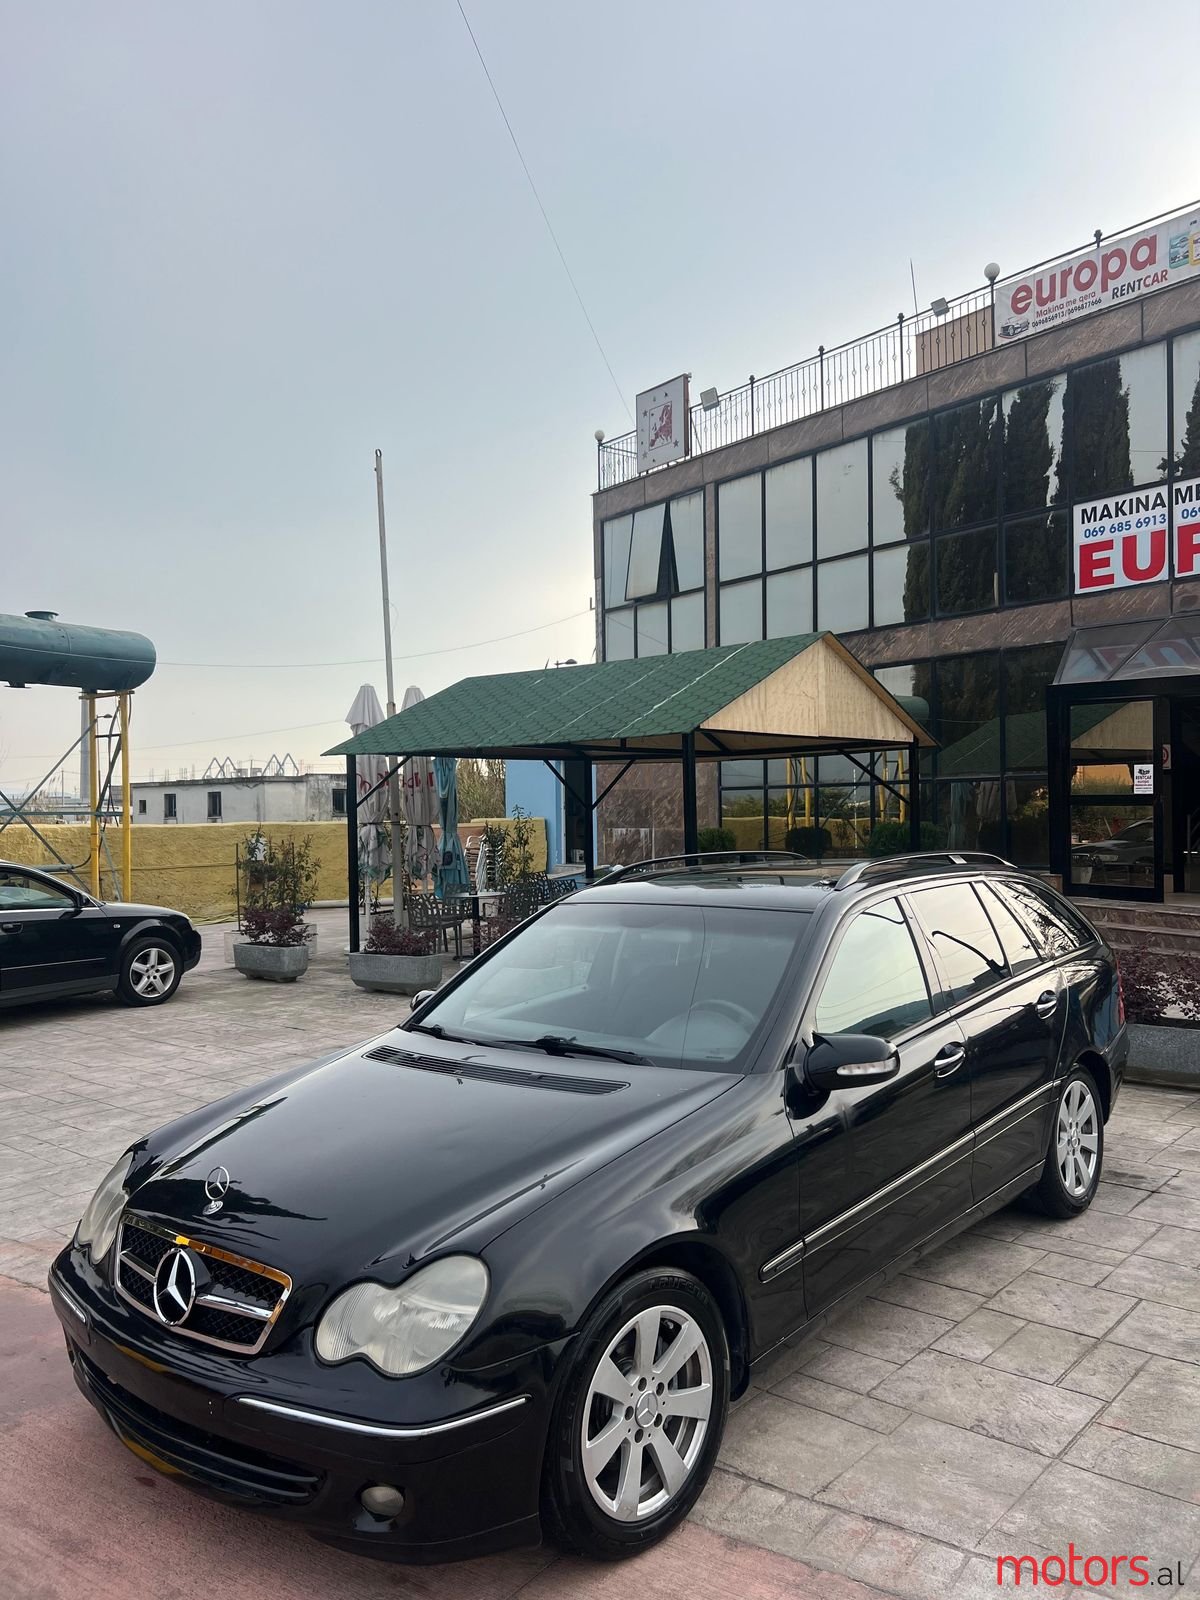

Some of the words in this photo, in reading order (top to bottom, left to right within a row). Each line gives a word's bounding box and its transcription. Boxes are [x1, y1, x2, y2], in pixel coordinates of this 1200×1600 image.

[1010, 234, 1157, 315] europa
[1036, 303, 1064, 318] Makina
[1065, 298, 1077, 307] me
[1081, 492, 1167, 525] MAKINA
[1084, 525, 1105, 538] 069
[1109, 520, 1132, 534] 685
[1135, 513, 1166, 529] 6913
[1181, 507, 1200, 519] 06
